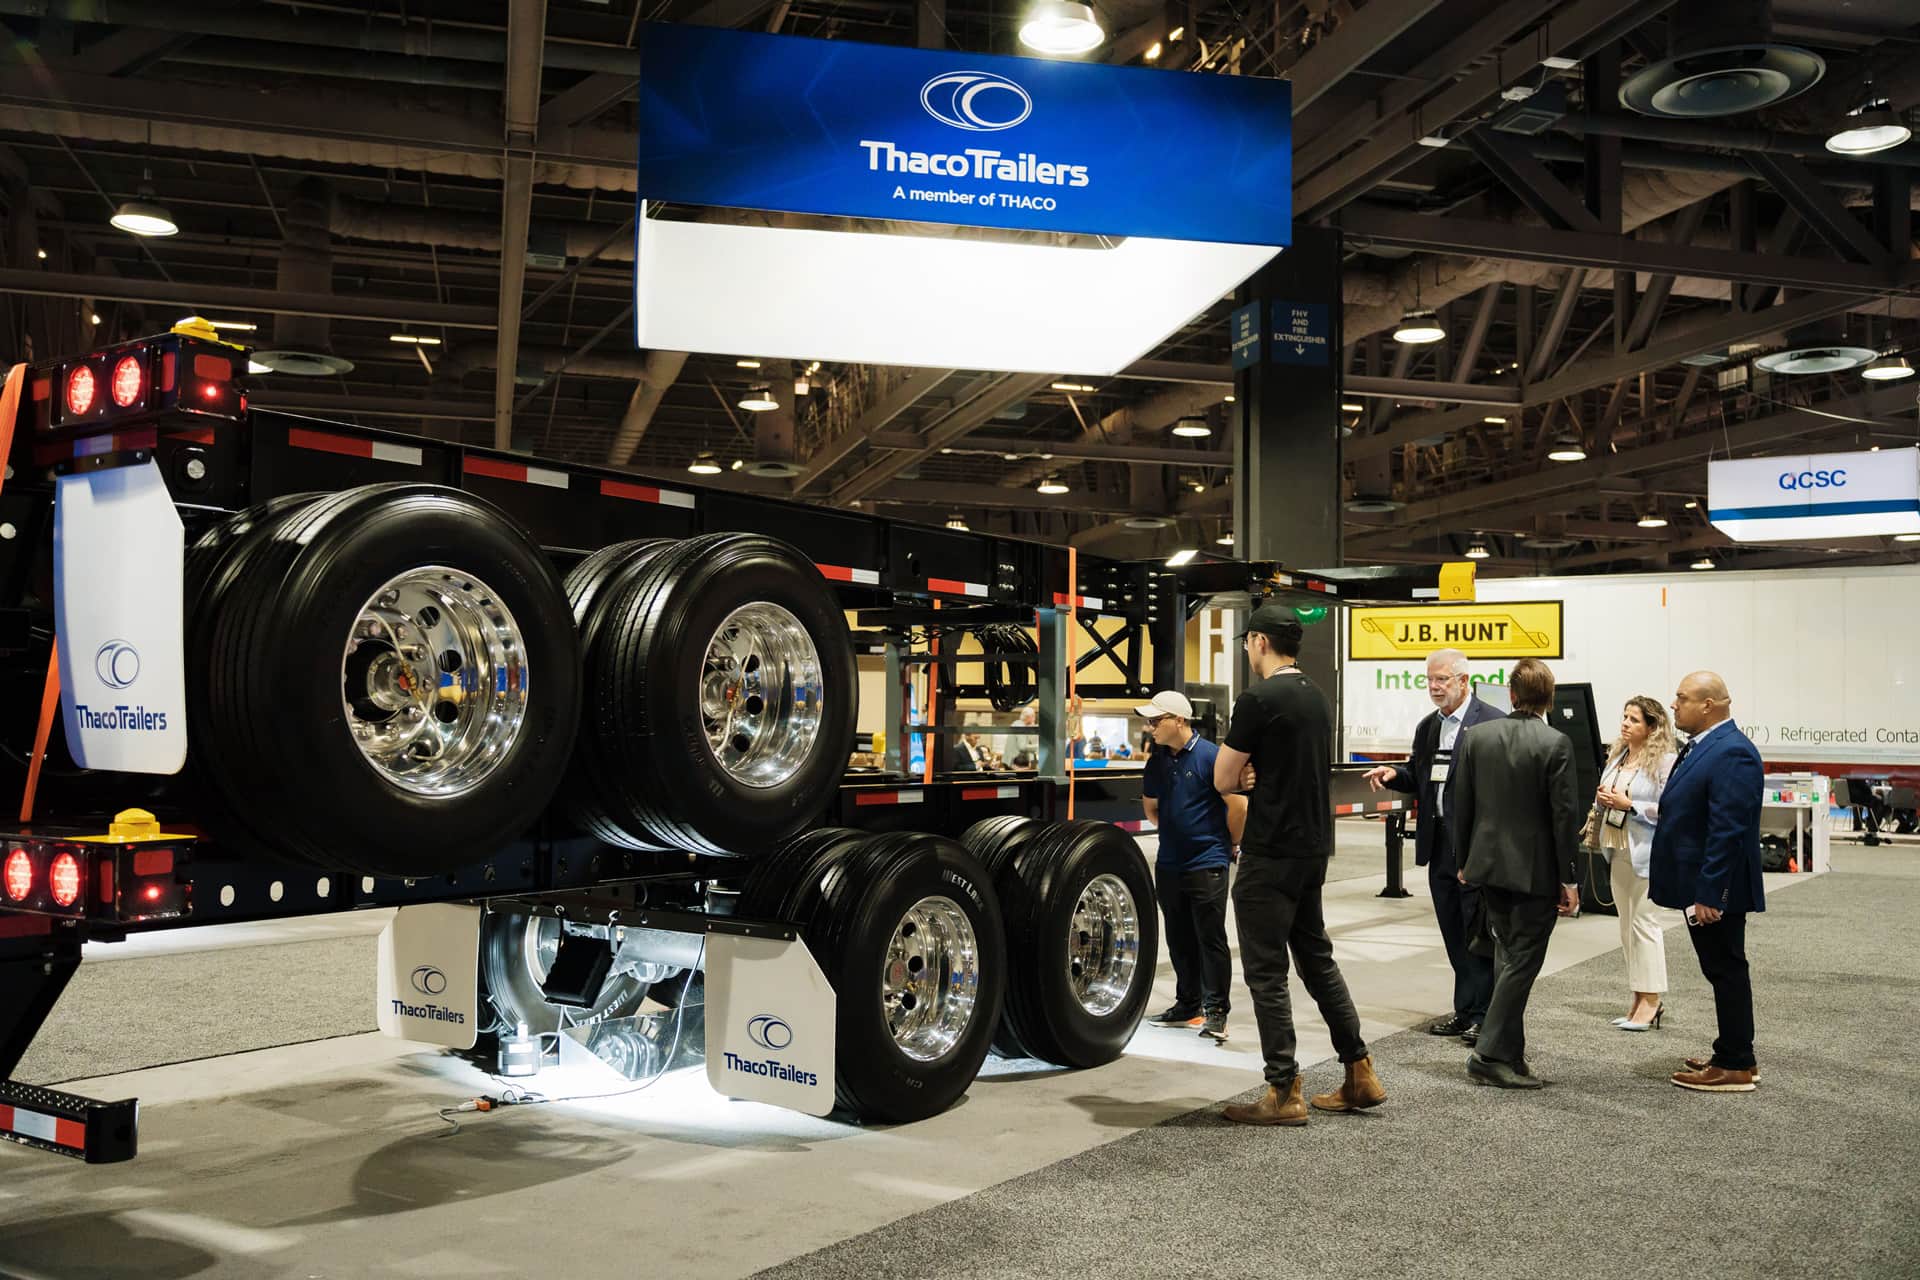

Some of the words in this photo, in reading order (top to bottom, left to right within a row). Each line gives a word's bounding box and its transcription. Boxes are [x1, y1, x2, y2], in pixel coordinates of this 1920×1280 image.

[860, 140, 1090, 187] ThacoTrailers
[892, 186, 906, 199] A
[909, 189, 976, 206] member
[978, 192, 997, 206] of
[998, 194, 1057, 211] THACO
[1291, 318, 1309, 326] AND
[1274, 333, 1326, 345] EXTINGUISHER
[1779, 469, 1847, 490] QCSC
[1444, 622, 1509, 642] HUNT
[76, 705, 167, 730] ThacoTrailers
[1357, 725, 1379, 737] ONLY
[1780, 726, 1867, 744] Refrigerated
[391, 999, 465, 1024] ThacoTrailers
[723, 1052, 818, 1086] ThacoTrailers
